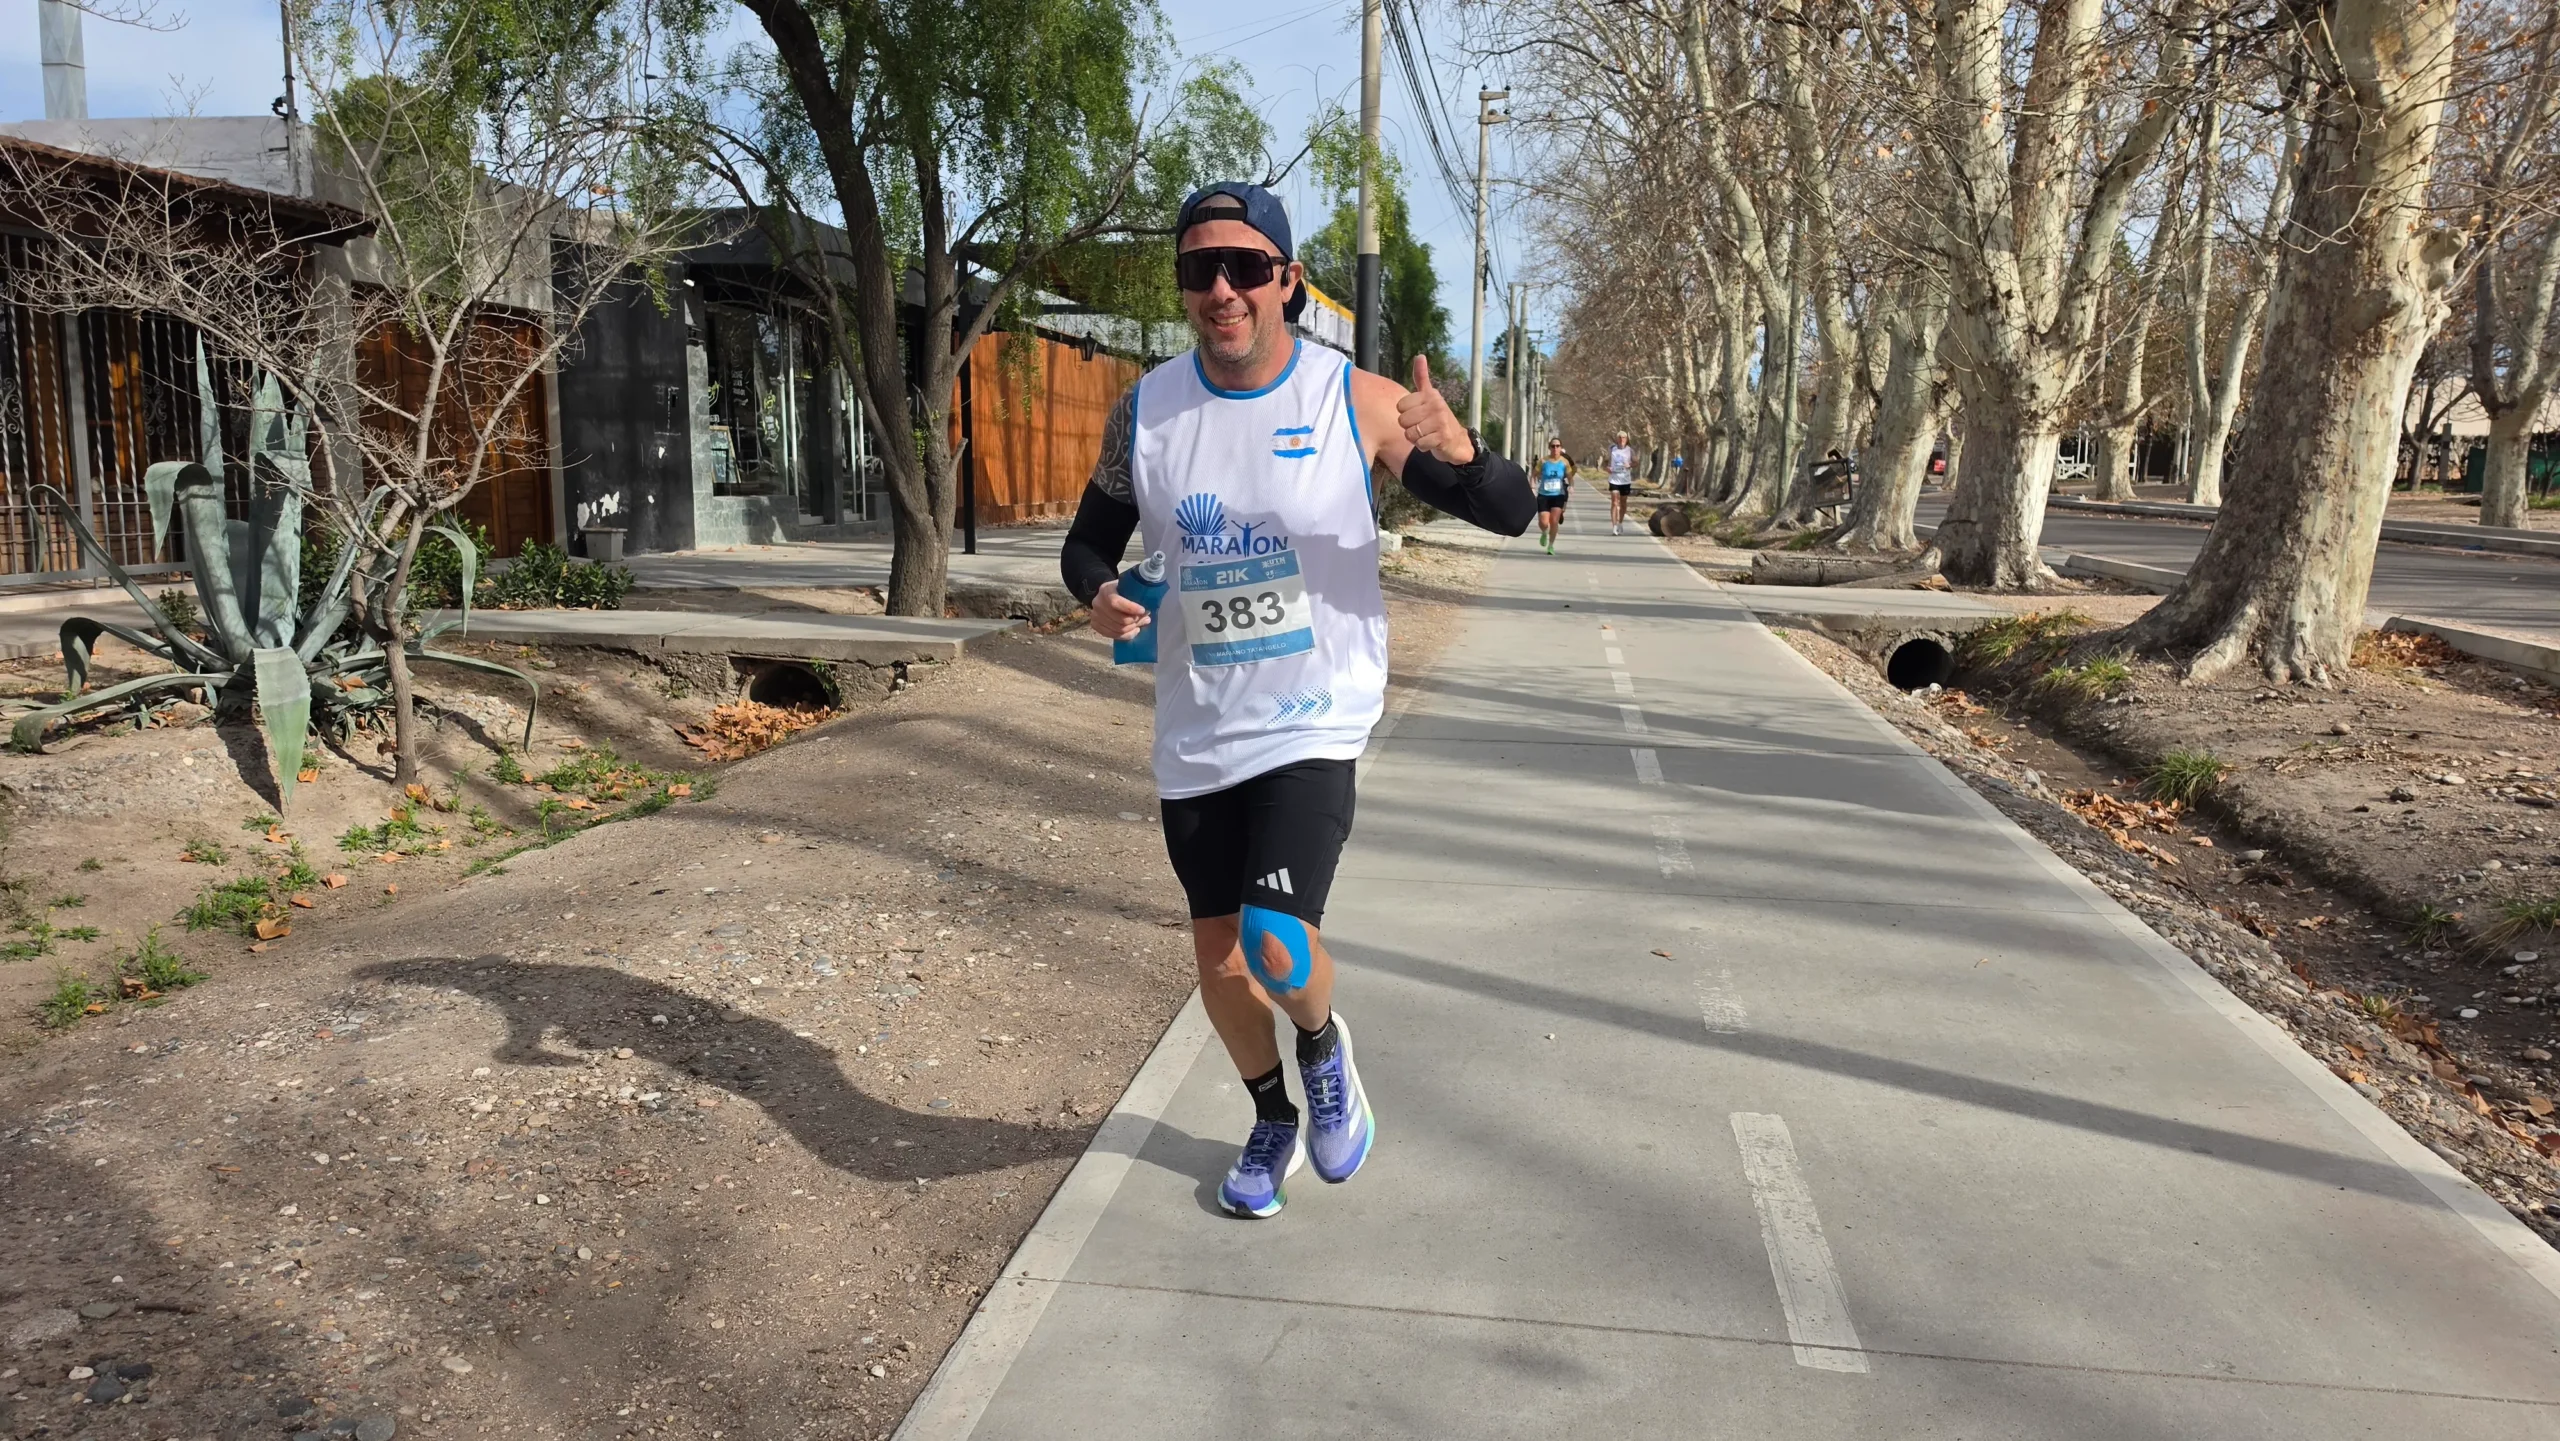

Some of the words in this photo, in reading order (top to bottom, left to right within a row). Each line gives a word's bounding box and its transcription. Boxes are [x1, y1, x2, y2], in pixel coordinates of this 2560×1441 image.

[1181, 535, 1288, 558] MARATON
[1216, 567, 1250, 585] 21K
[1202, 591, 1285, 633] 383
[1216, 649, 1246, 657] MARIANO
[1247, 642, 1287, 654] TATANGELO
